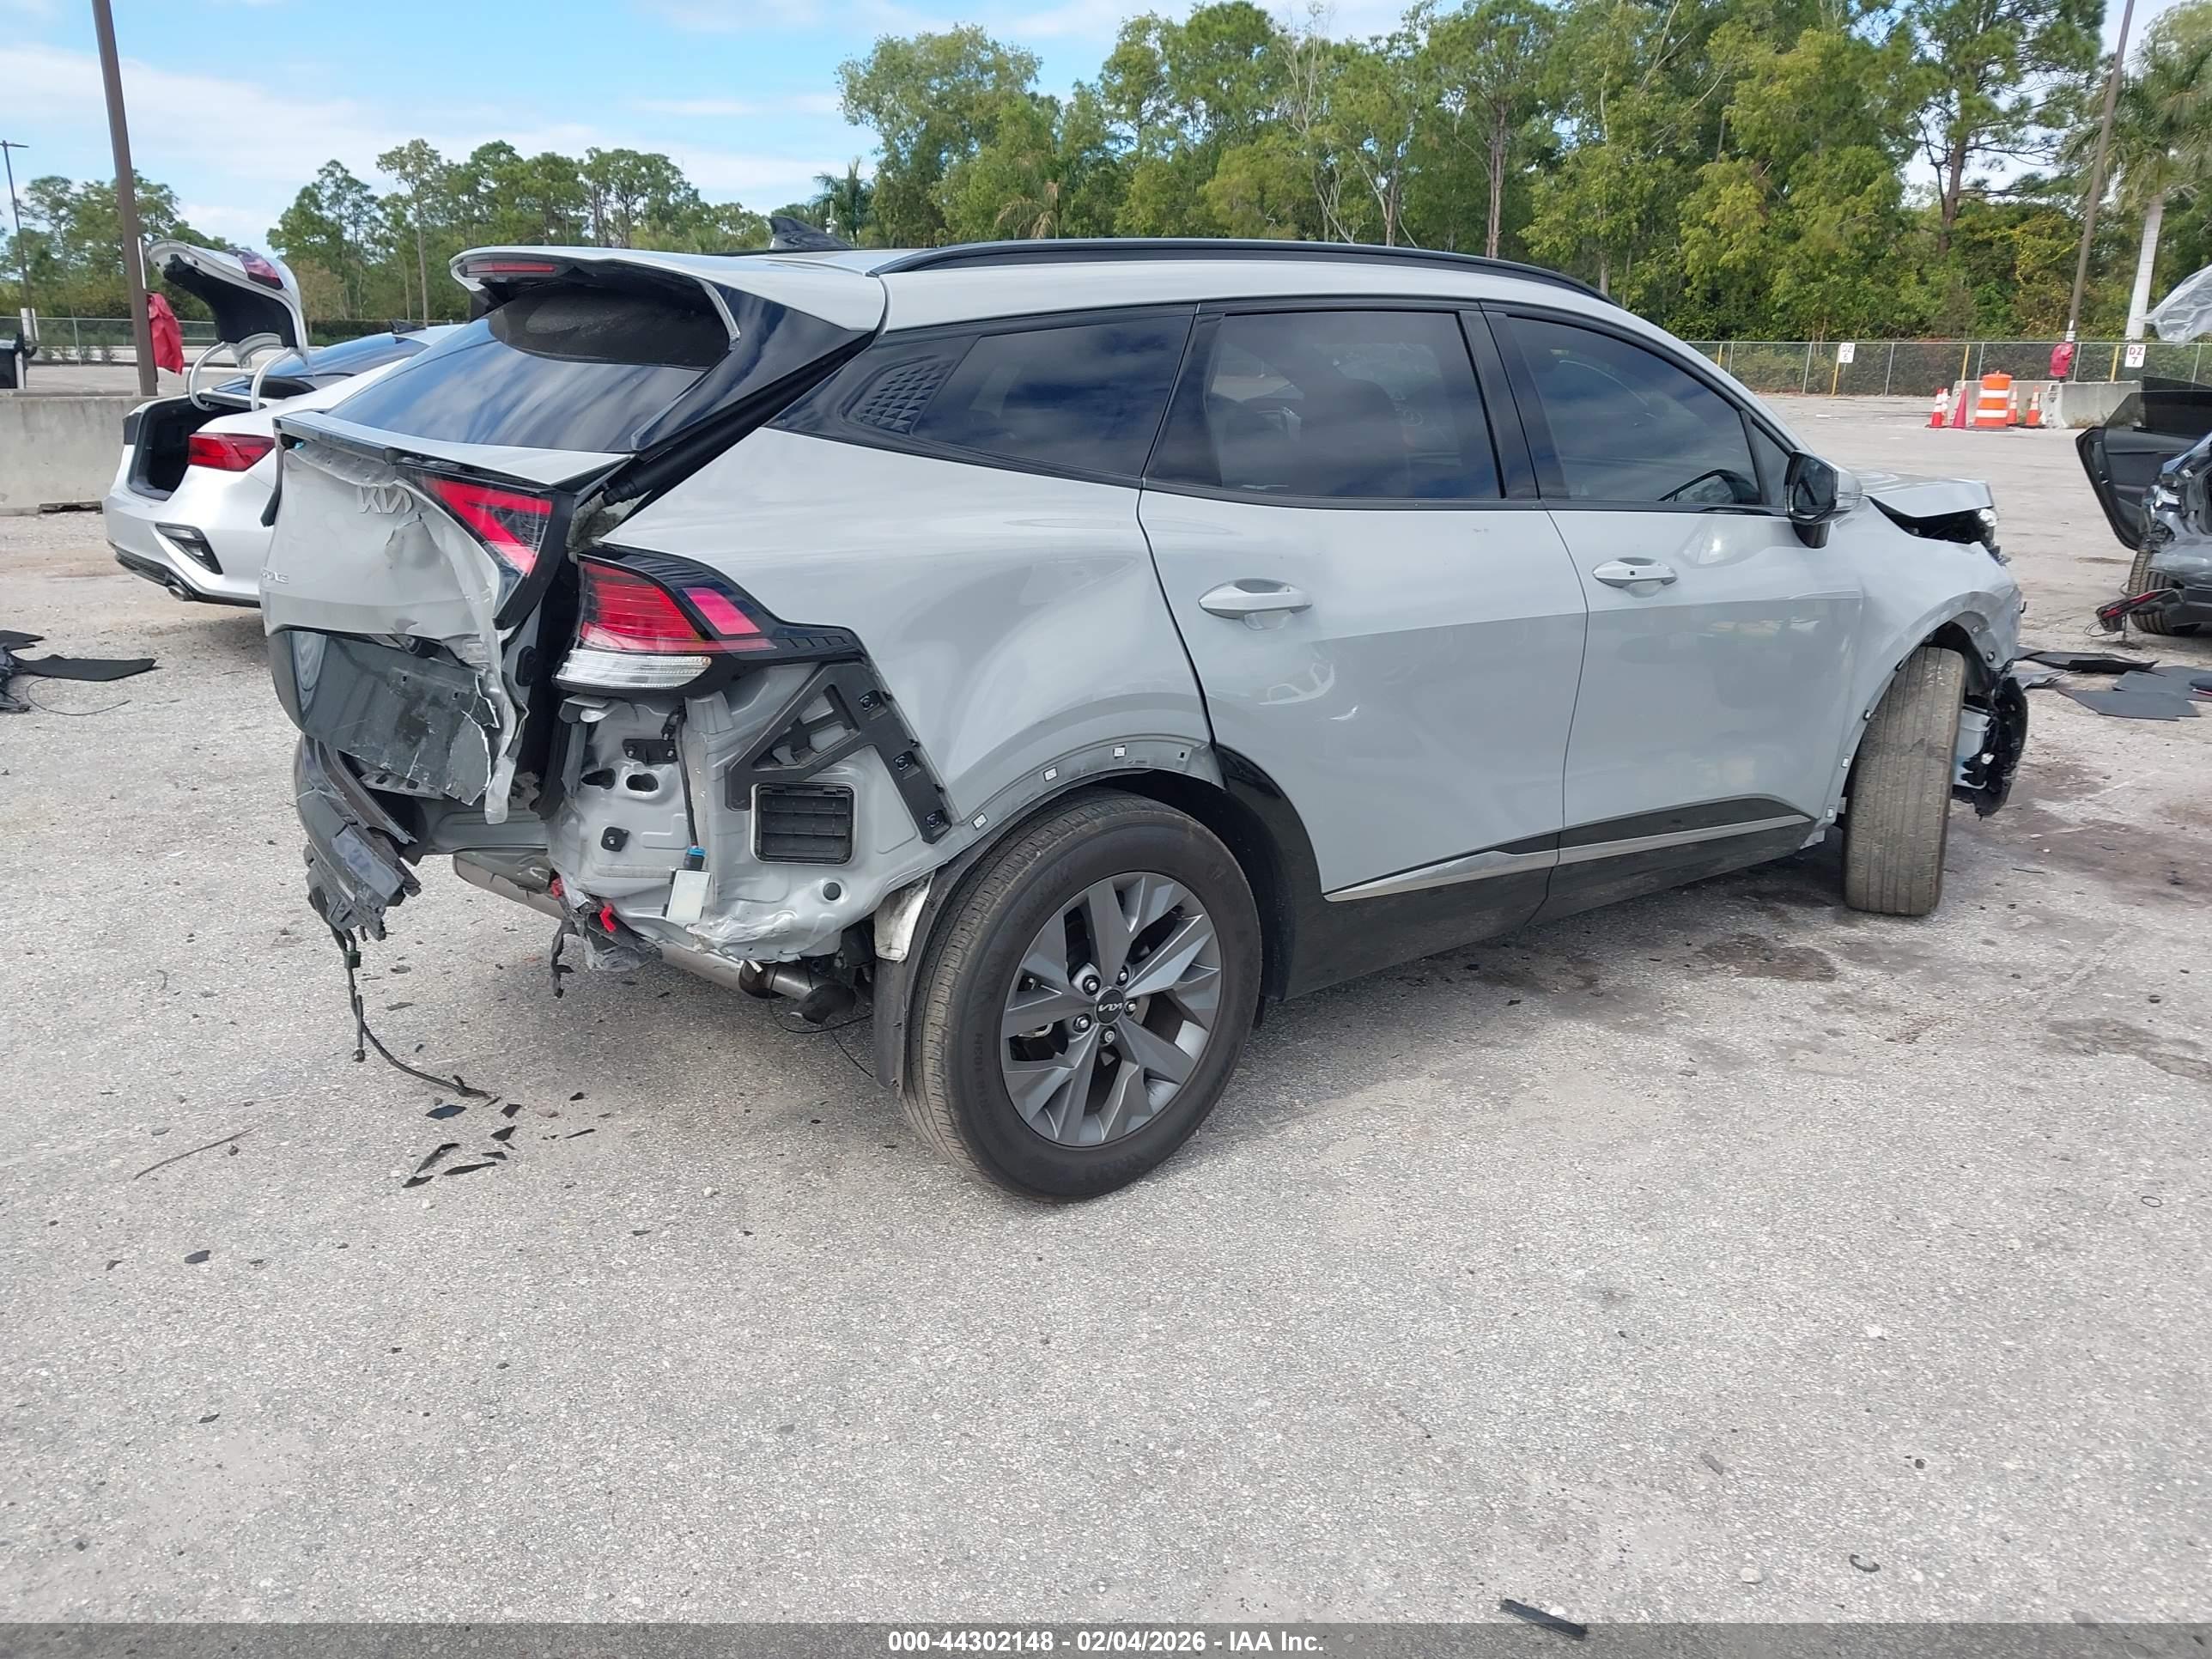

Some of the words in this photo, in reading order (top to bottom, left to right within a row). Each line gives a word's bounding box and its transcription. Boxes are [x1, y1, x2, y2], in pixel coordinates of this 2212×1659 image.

[1842, 344, 1854, 353] DZ
[2129, 346, 2144, 356] DZ
[2131, 356, 2138, 365] 7
[357, 486, 413, 514] KIA
